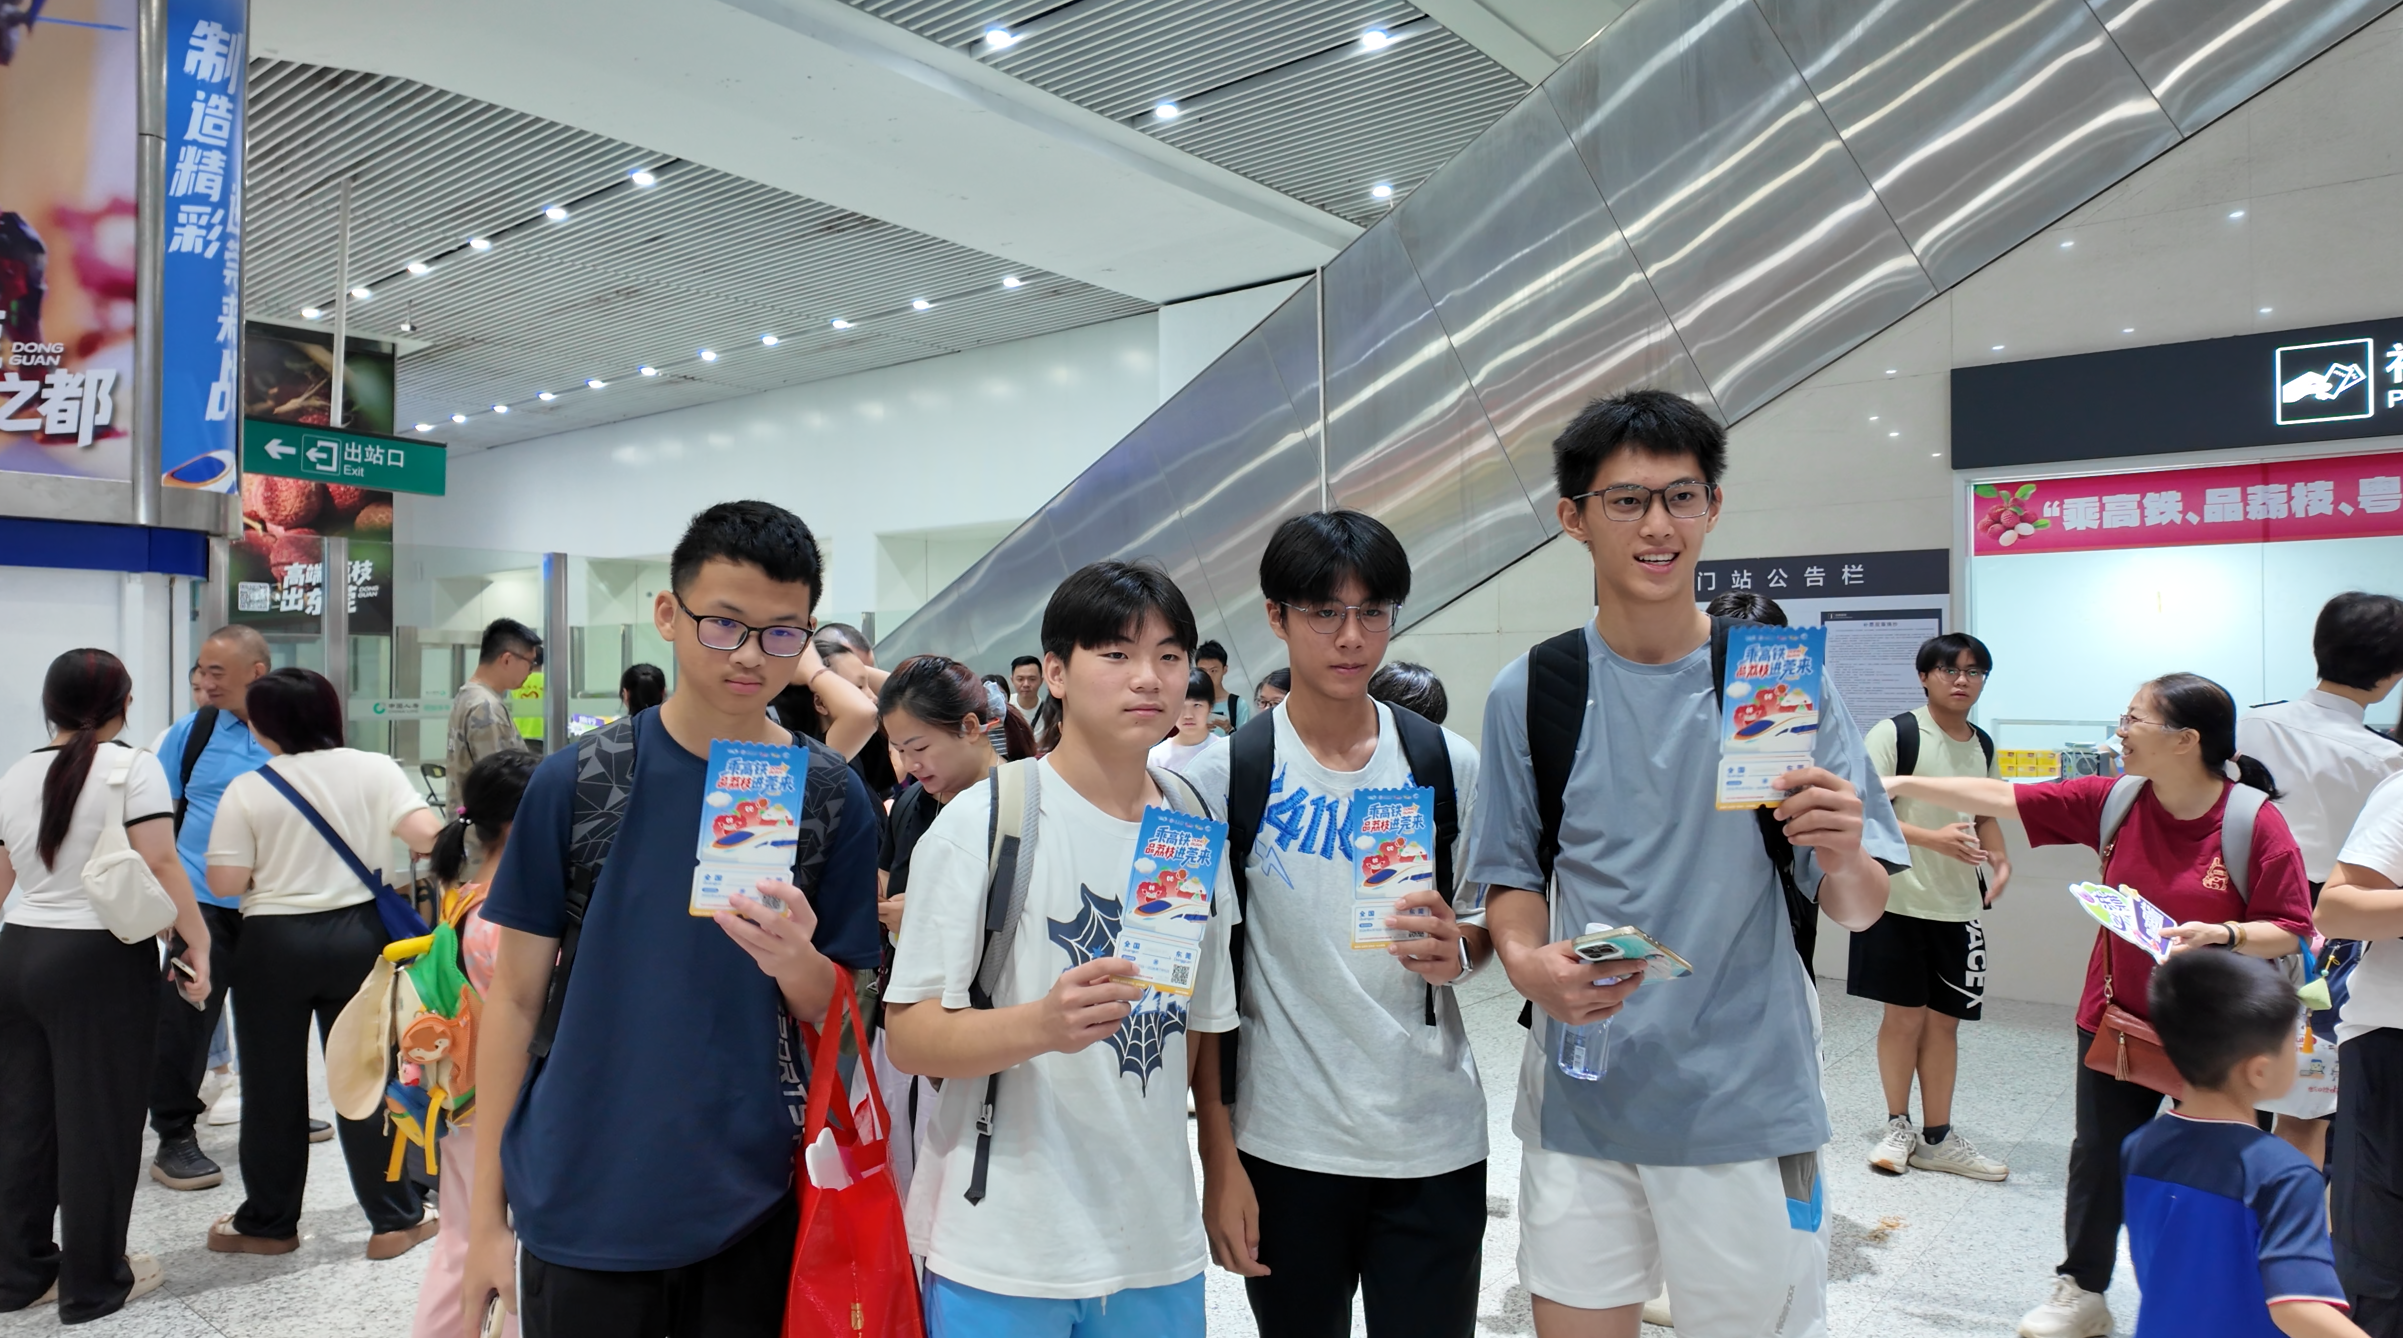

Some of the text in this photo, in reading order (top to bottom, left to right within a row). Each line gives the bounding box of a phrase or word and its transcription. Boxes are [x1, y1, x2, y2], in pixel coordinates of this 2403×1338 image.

[168, 19, 243, 259] 制造精彩
[12, 342, 64, 353] DONG
[9, 354, 60, 366] GUAN
[0, 368, 117, 447] 之都
[344, 442, 405, 468] 出站口
[343, 464, 365, 477] Exit
[283, 560, 373, 586] 高端枝
[1697, 564, 1865, 592] 门站公告栏
[1737, 643, 1787, 665] 乘高铁
[1363, 802, 1403, 822] 乘高铁
[1361, 813, 1426, 836] 品荔枝进莞来
[1149, 826, 1192, 847] 乘高铁
[1144, 842, 1212, 868] 品荔枝进莞来
